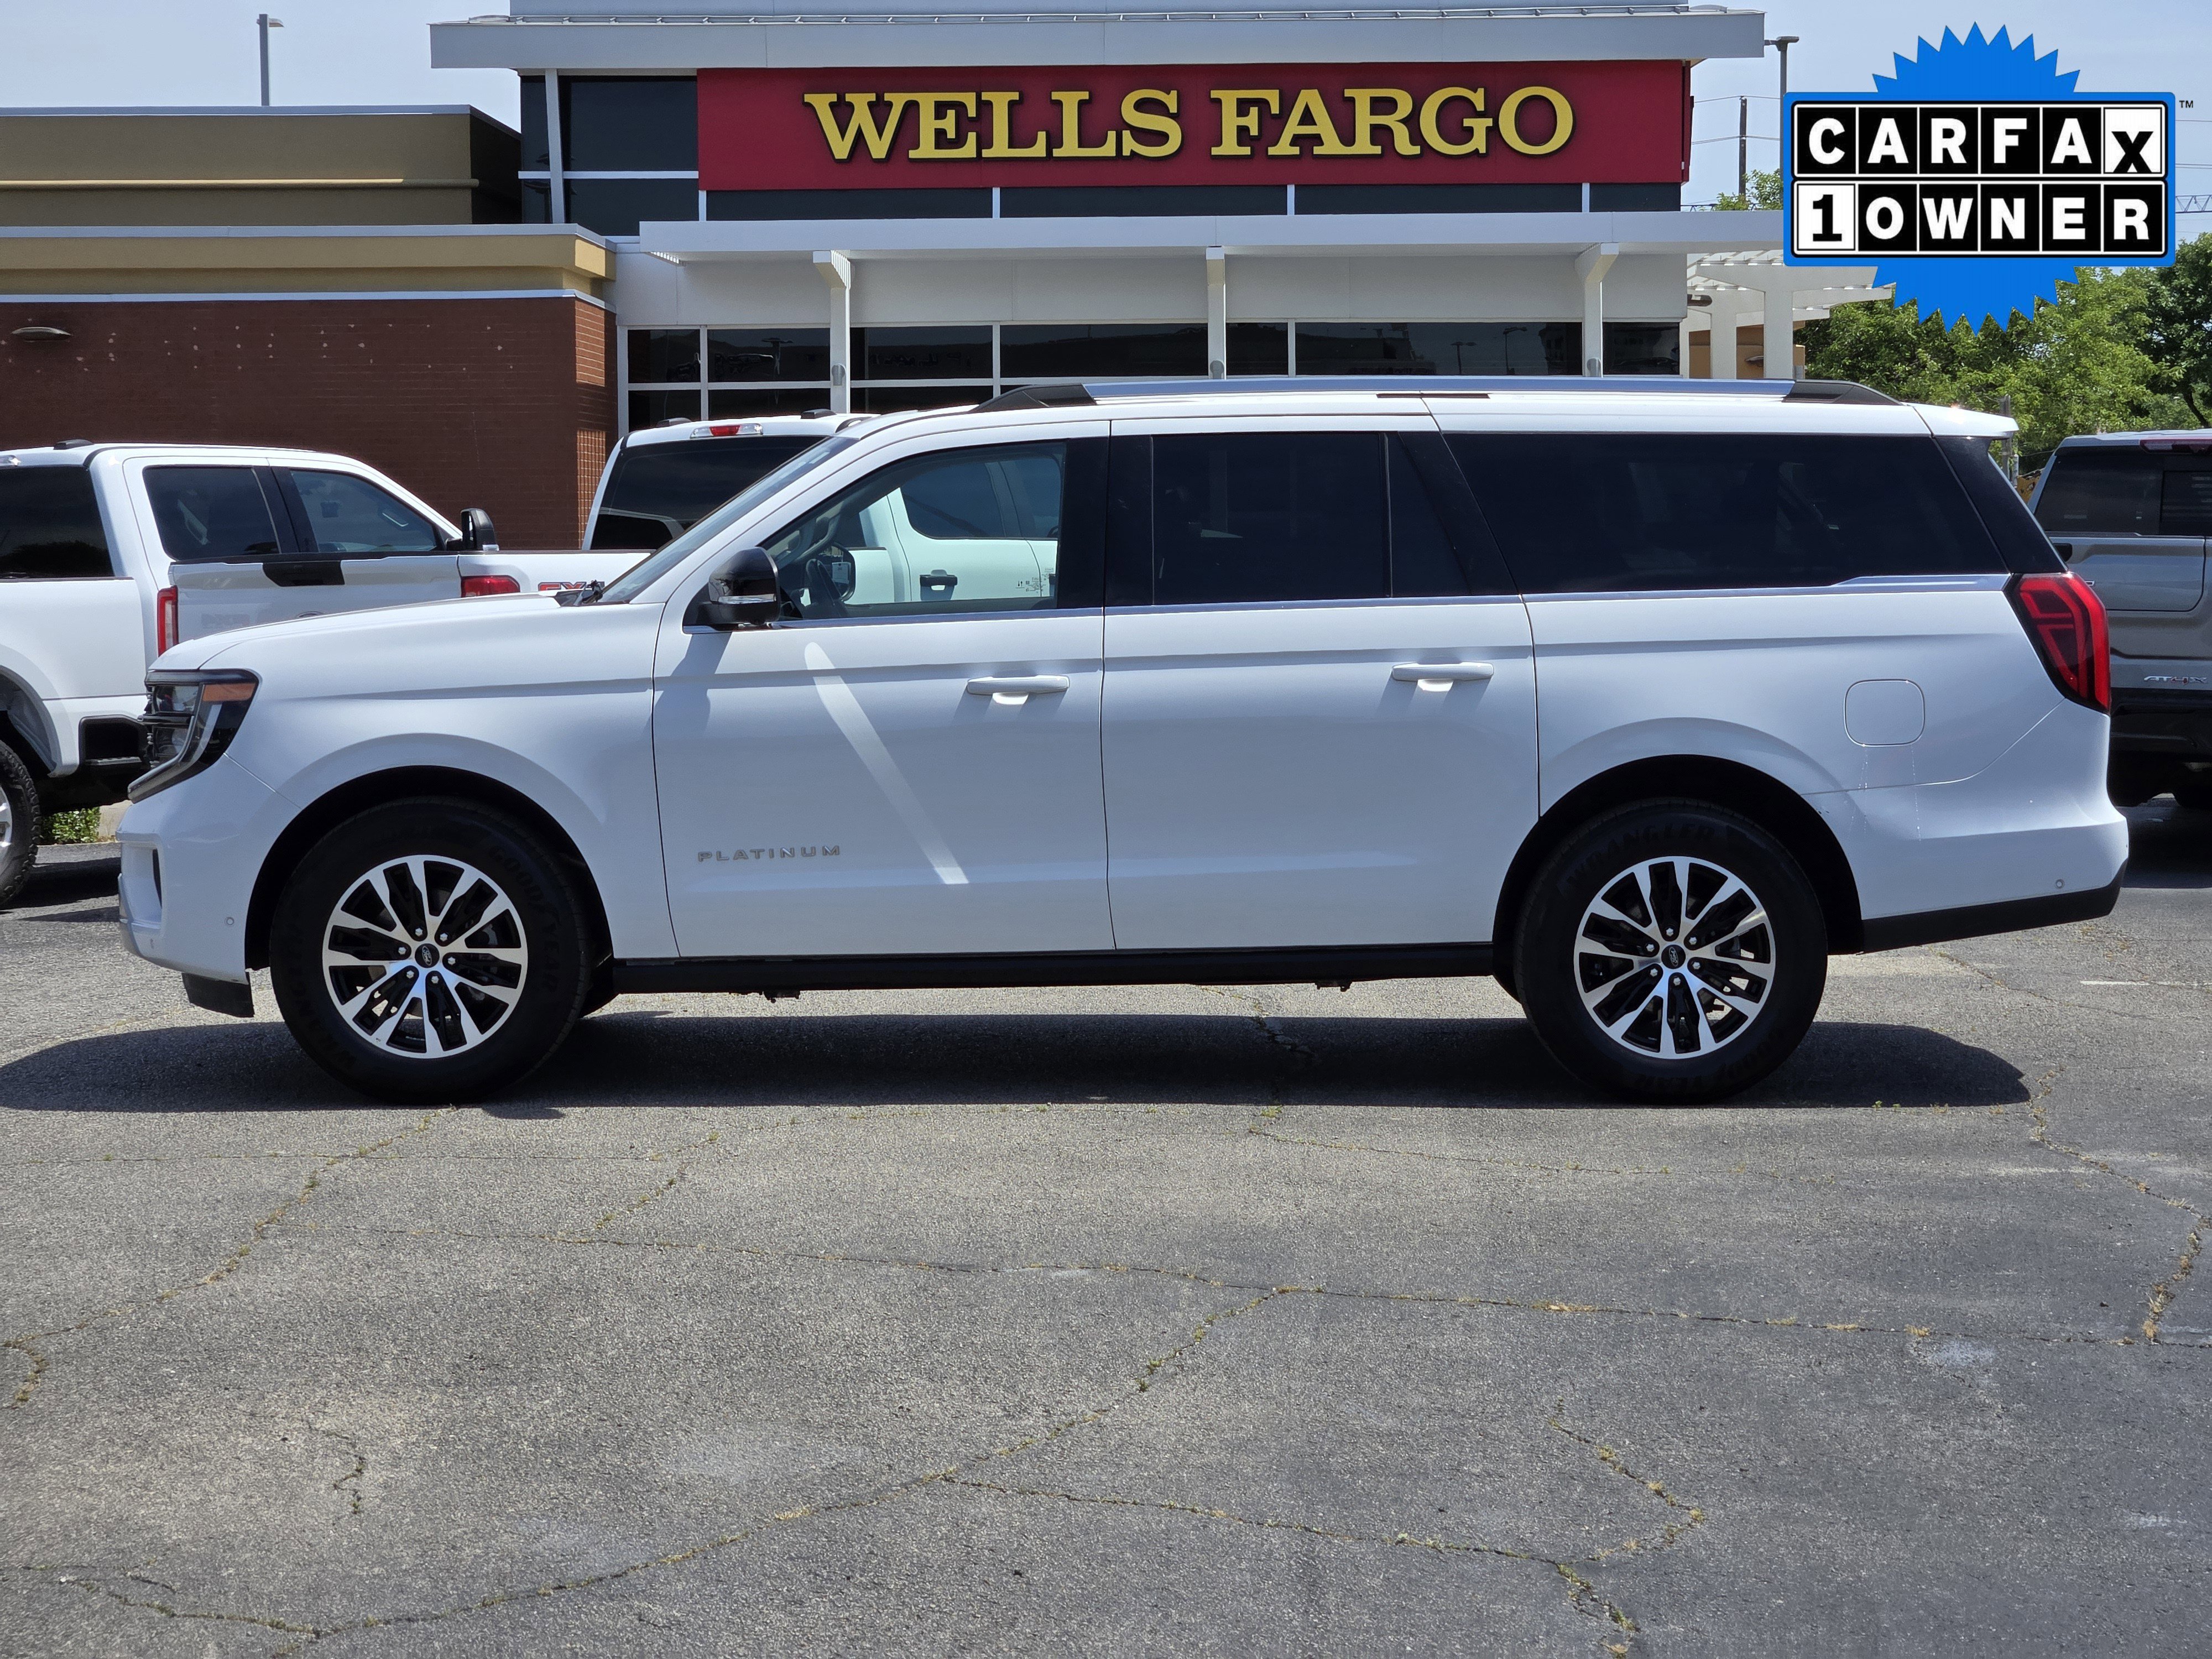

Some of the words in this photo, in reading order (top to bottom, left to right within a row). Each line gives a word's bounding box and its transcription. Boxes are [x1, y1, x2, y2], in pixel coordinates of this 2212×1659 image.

[805, 89, 1182, 159] WELLS
[1211, 87, 1573, 156] FARGO
[2144, 676, 2207, 685] AT4X
[697, 845, 840, 862] PLATINUM
[1564, 822, 1717, 890] WRANGLER
